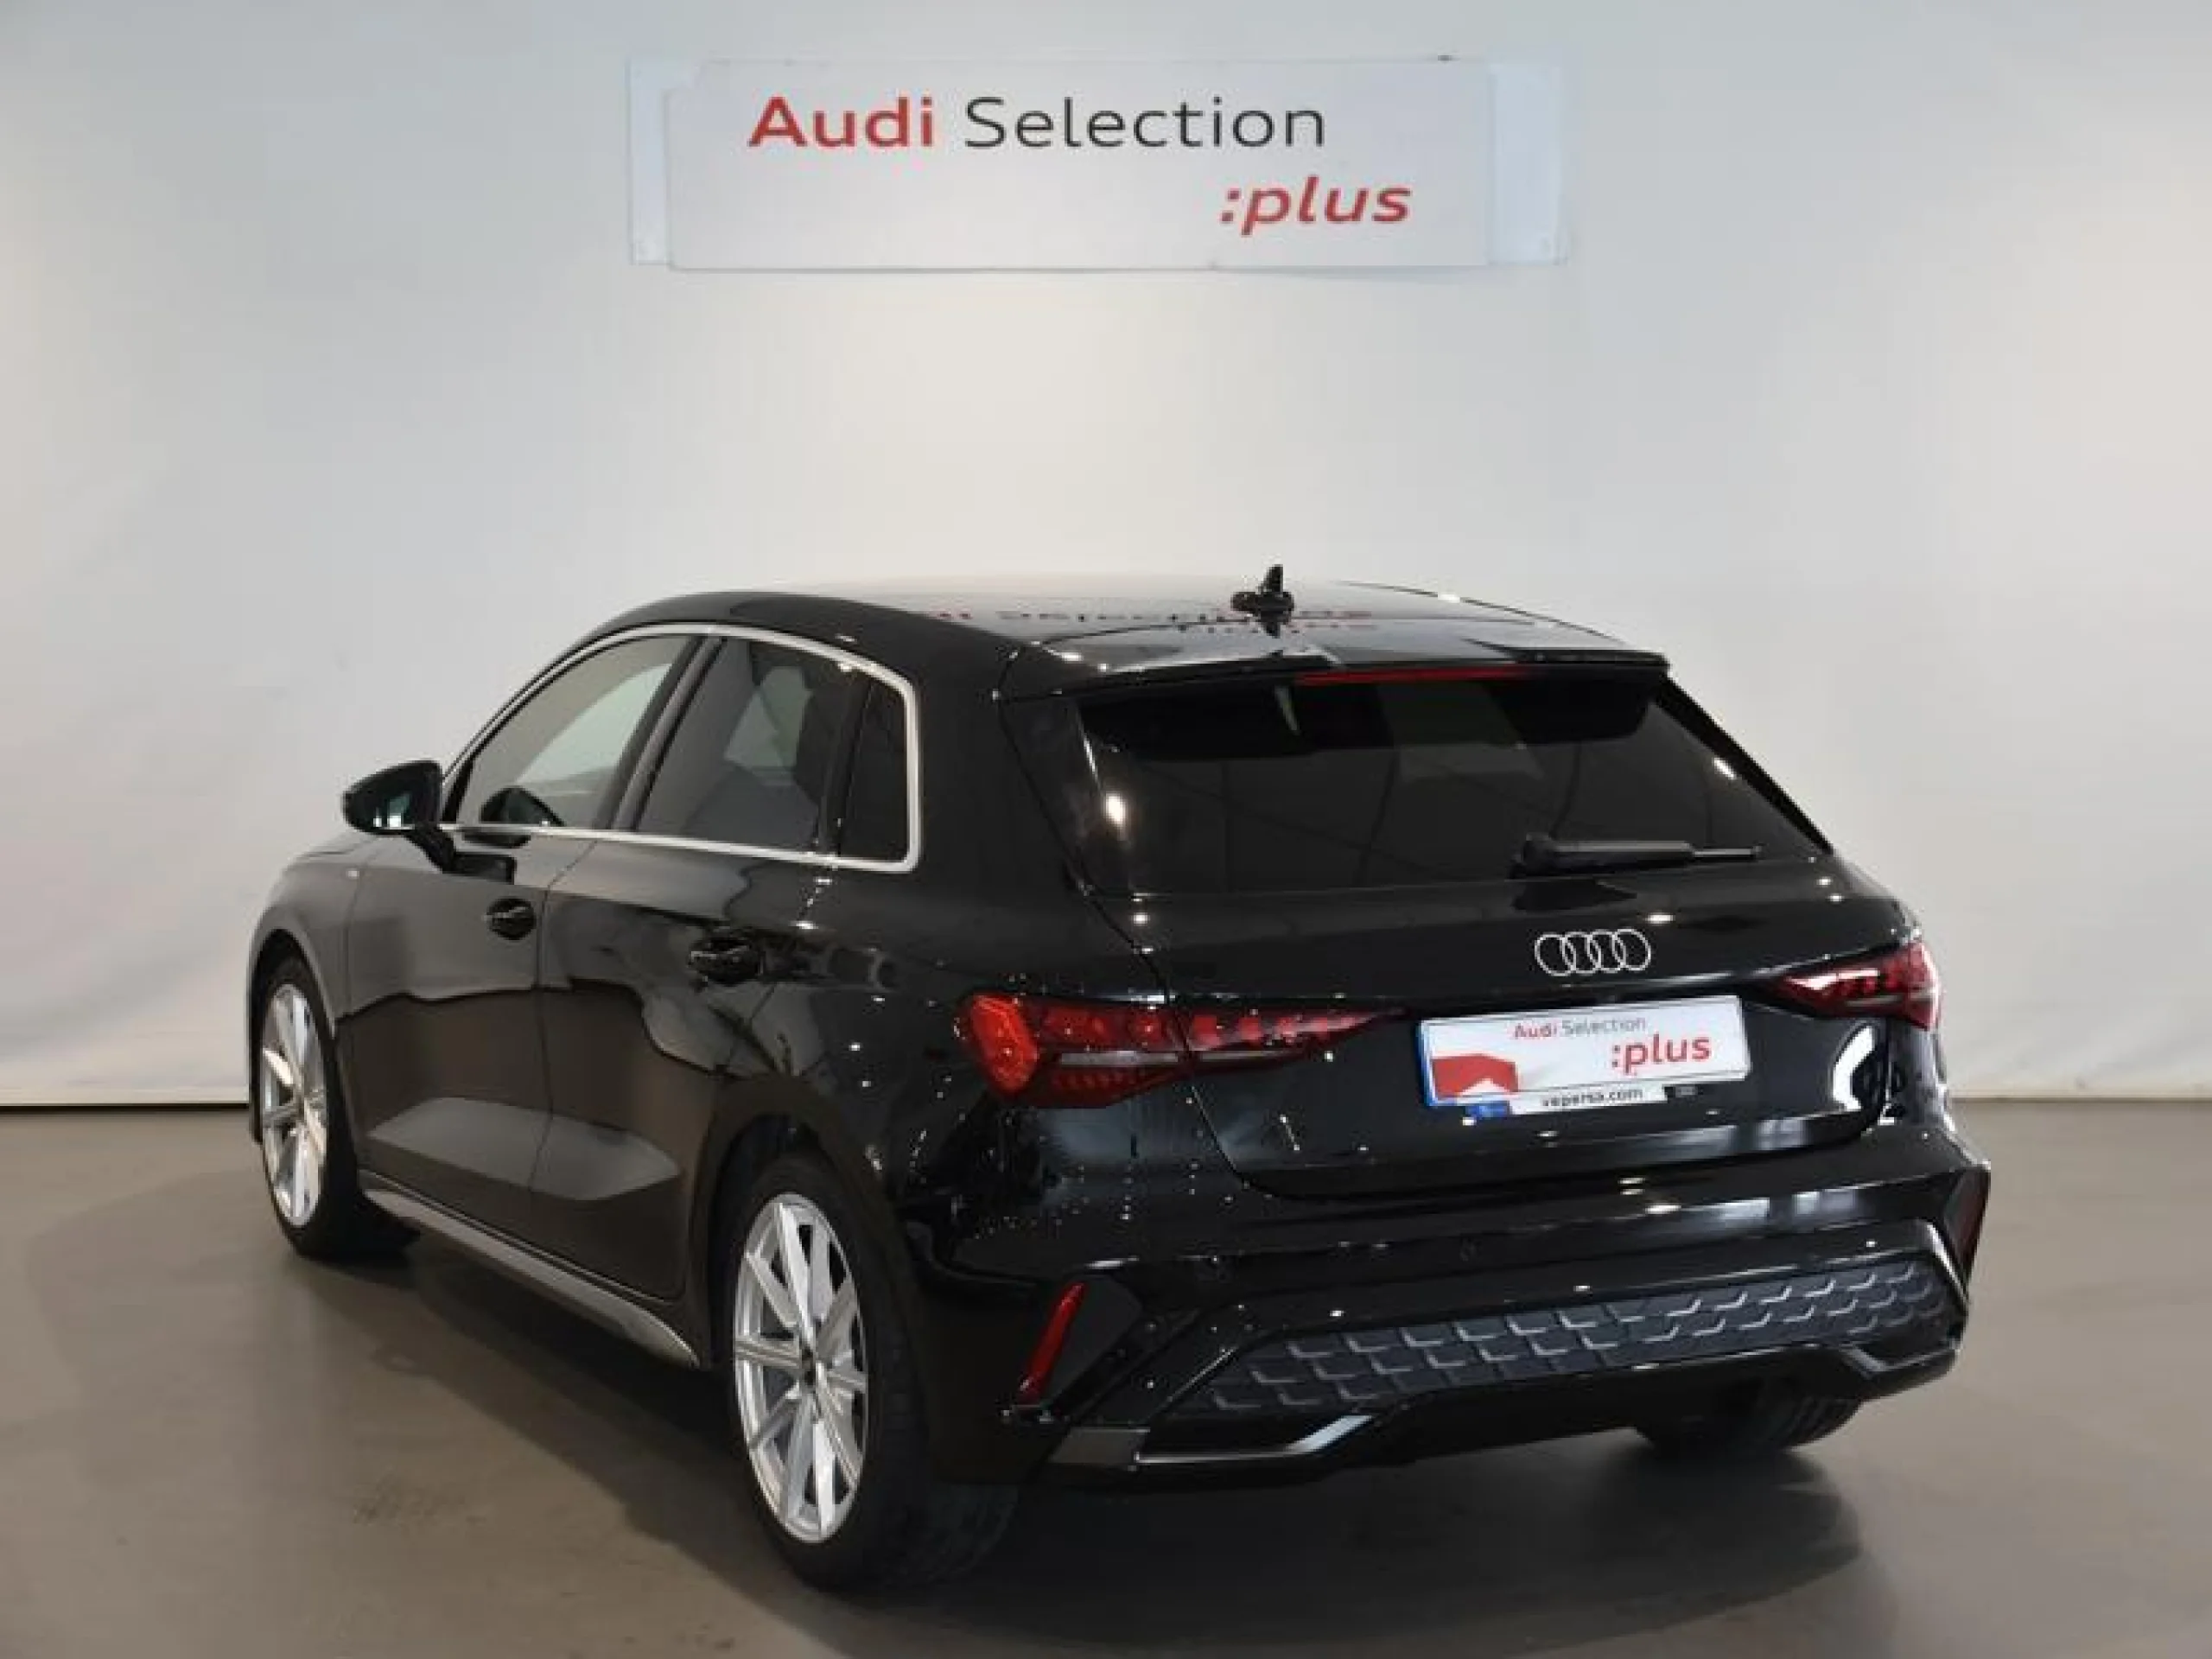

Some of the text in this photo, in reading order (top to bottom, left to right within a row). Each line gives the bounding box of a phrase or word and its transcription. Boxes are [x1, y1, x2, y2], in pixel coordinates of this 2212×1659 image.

[749, 96, 1325, 149] Audi Selection
[1219, 175, 1412, 236] :plus
[1514, 1016, 1646, 1039] Audi Selection
[1611, 1034, 1711, 1073] :plus
